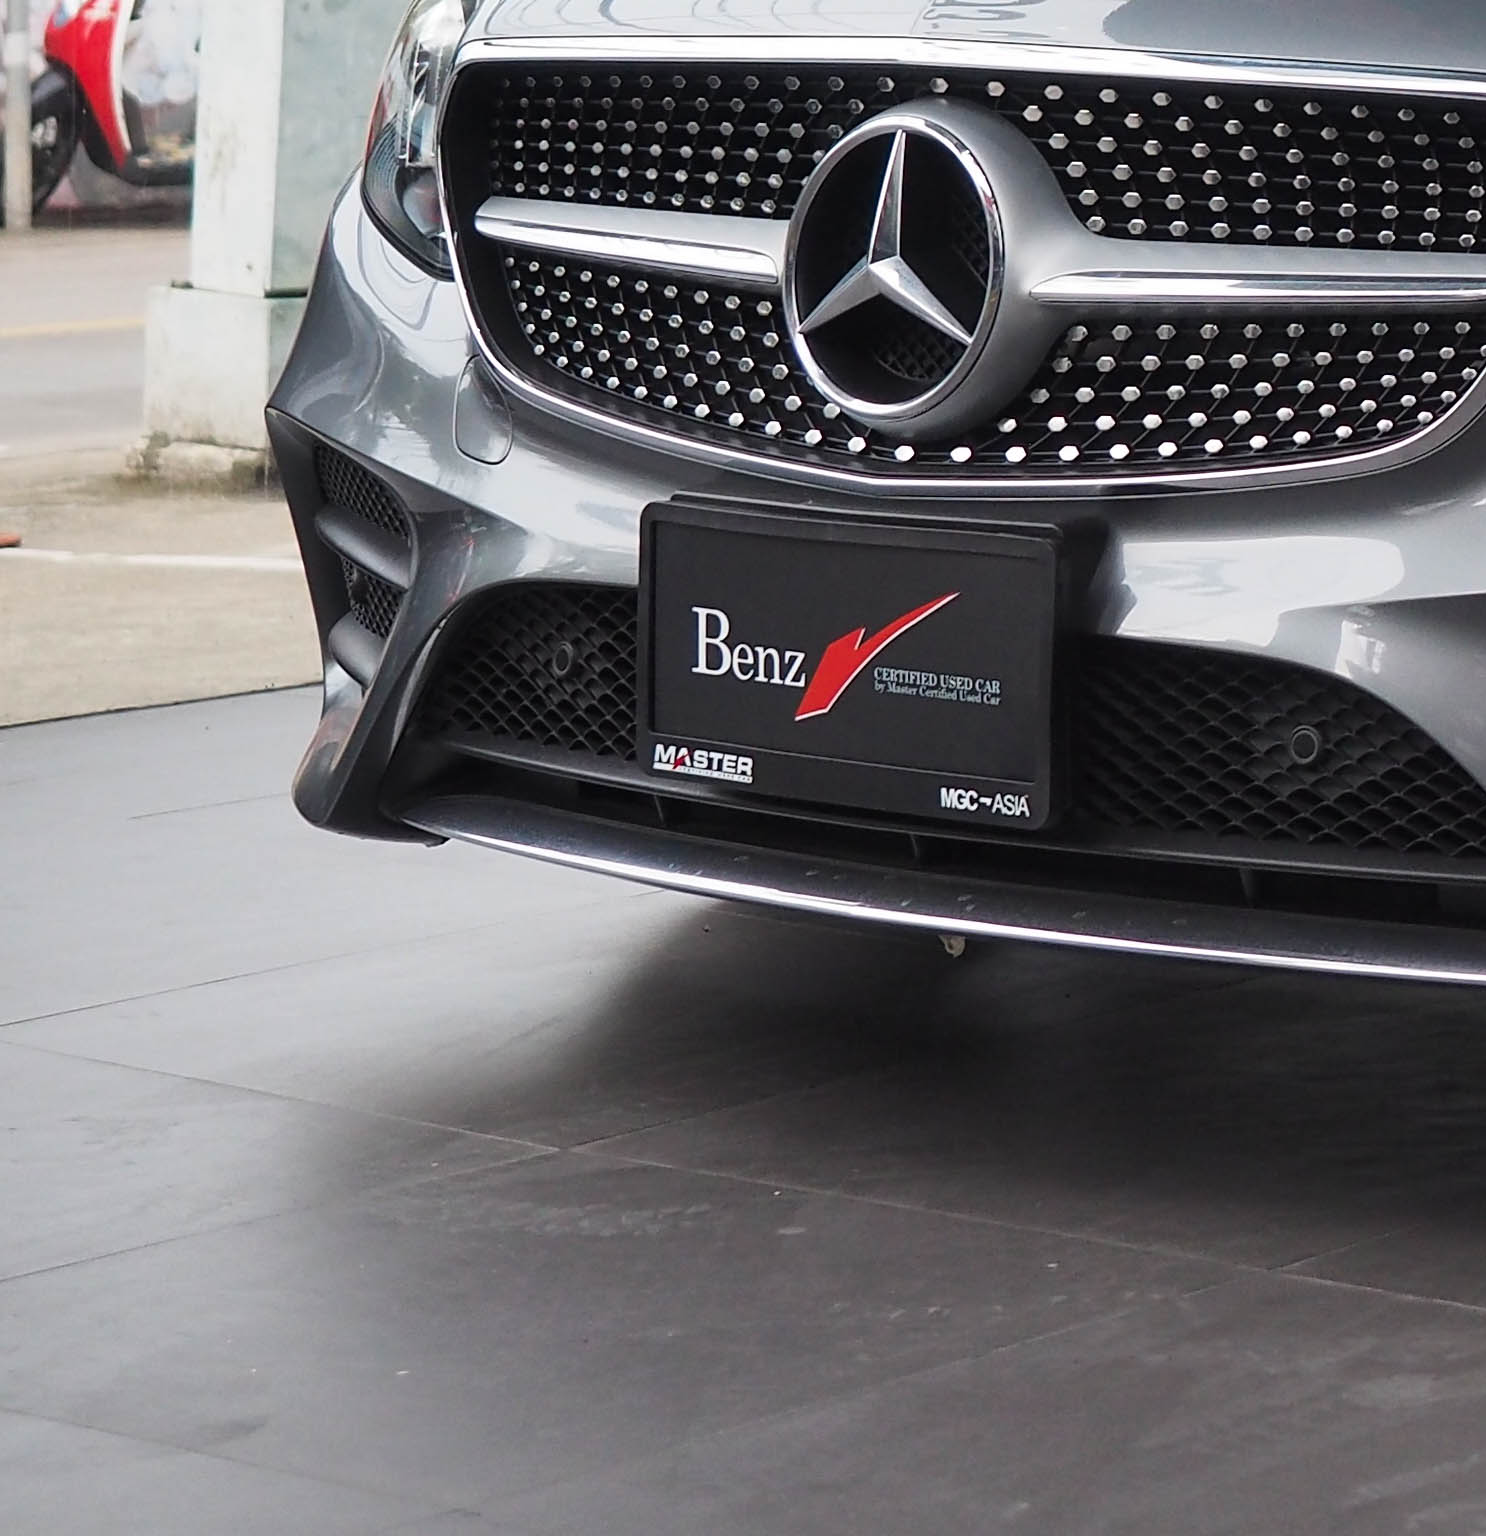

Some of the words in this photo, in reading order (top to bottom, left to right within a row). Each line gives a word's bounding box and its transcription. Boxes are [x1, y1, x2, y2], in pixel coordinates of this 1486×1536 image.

[691, 605, 807, 688] Benz
[873, 667, 937, 686] CERTIFIED
[939, 675, 973, 691] USED
[975, 679, 1001, 694] CAR
[874, 680, 886, 693] by
[887, 681, 917, 696] Master
[919, 686, 957, 701] Certified
[959, 690, 981, 703] Used
[983, 693, 1001, 706] Car
[654, 743, 753, 775] MASTER
